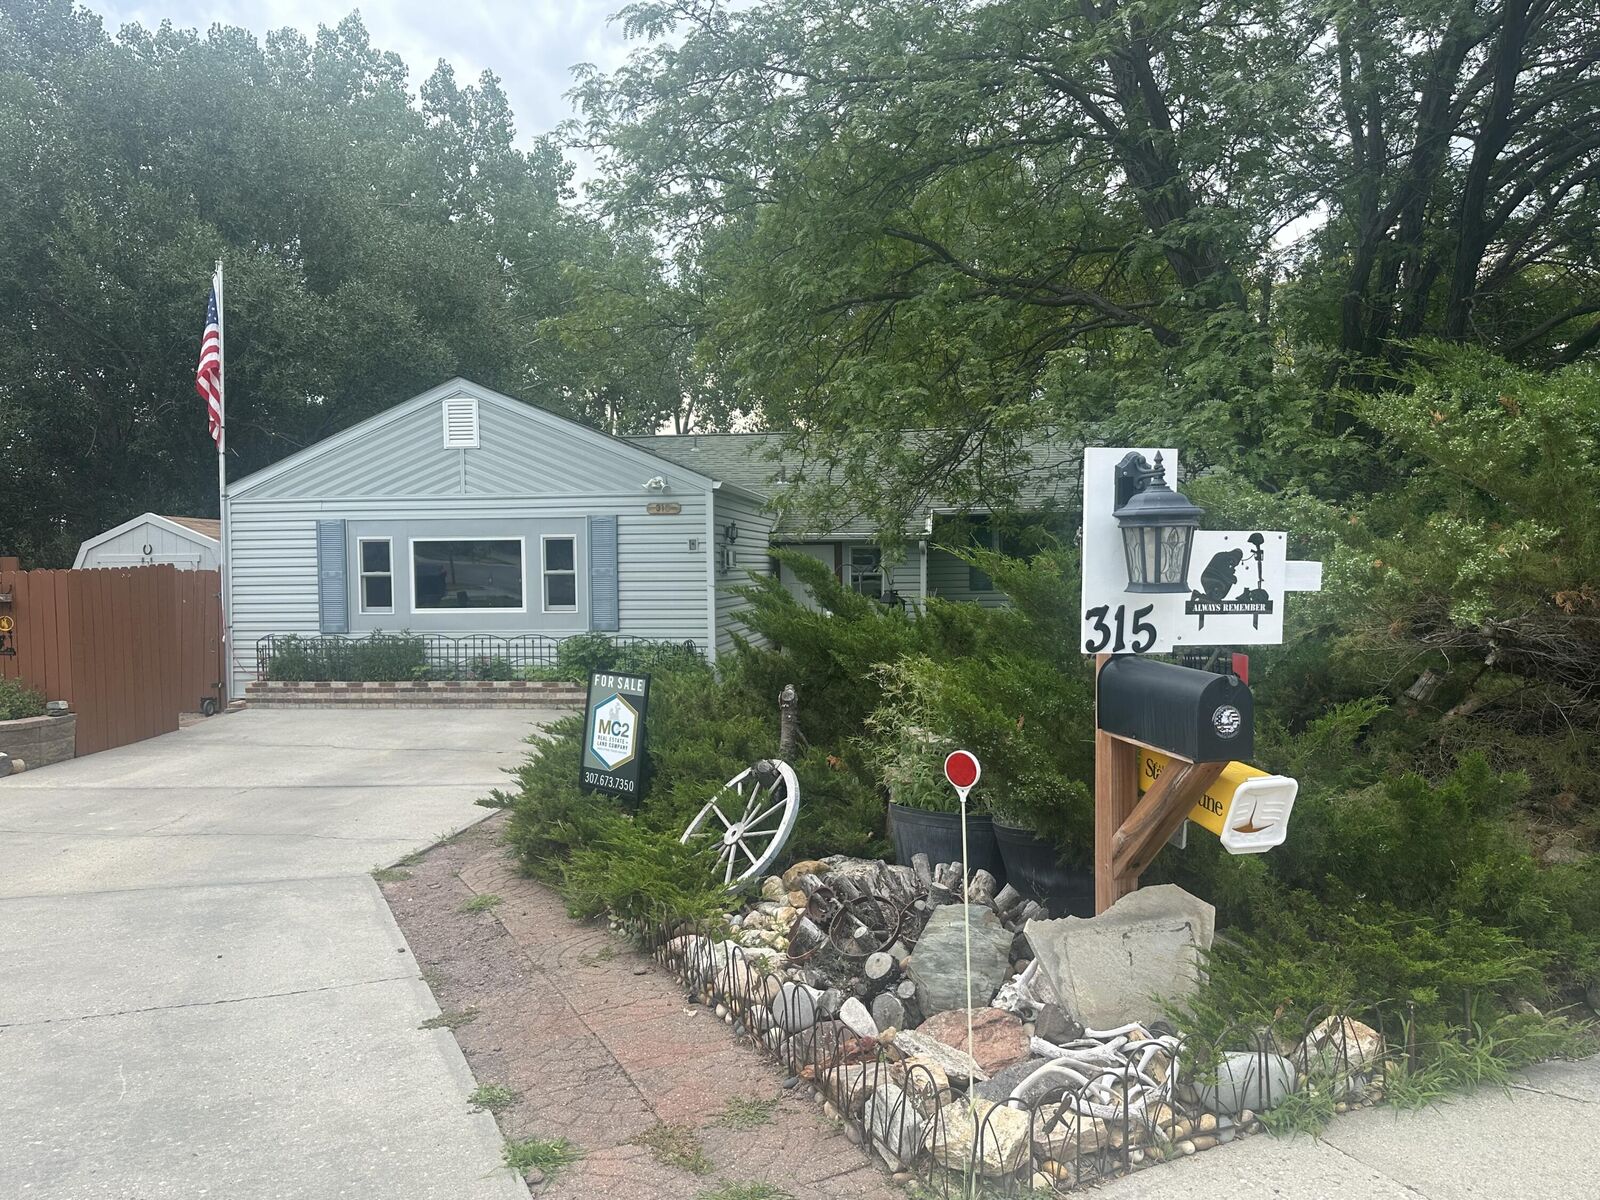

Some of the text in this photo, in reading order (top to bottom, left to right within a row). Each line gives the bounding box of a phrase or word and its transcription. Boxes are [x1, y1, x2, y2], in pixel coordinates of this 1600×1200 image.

[1192, 603, 1266, 612] ALWAYS REMEMBER
[1085, 603, 1157, 653] 315
[594, 674, 643, 692] FOR SALE
[598, 719, 630, 738] MC2
[597, 734, 608, 742] REAL
[609, 736, 625, 744] ESTATE
[609, 742, 628, 751] COMPANY
[584, 771, 634, 792] 307.673.7350
